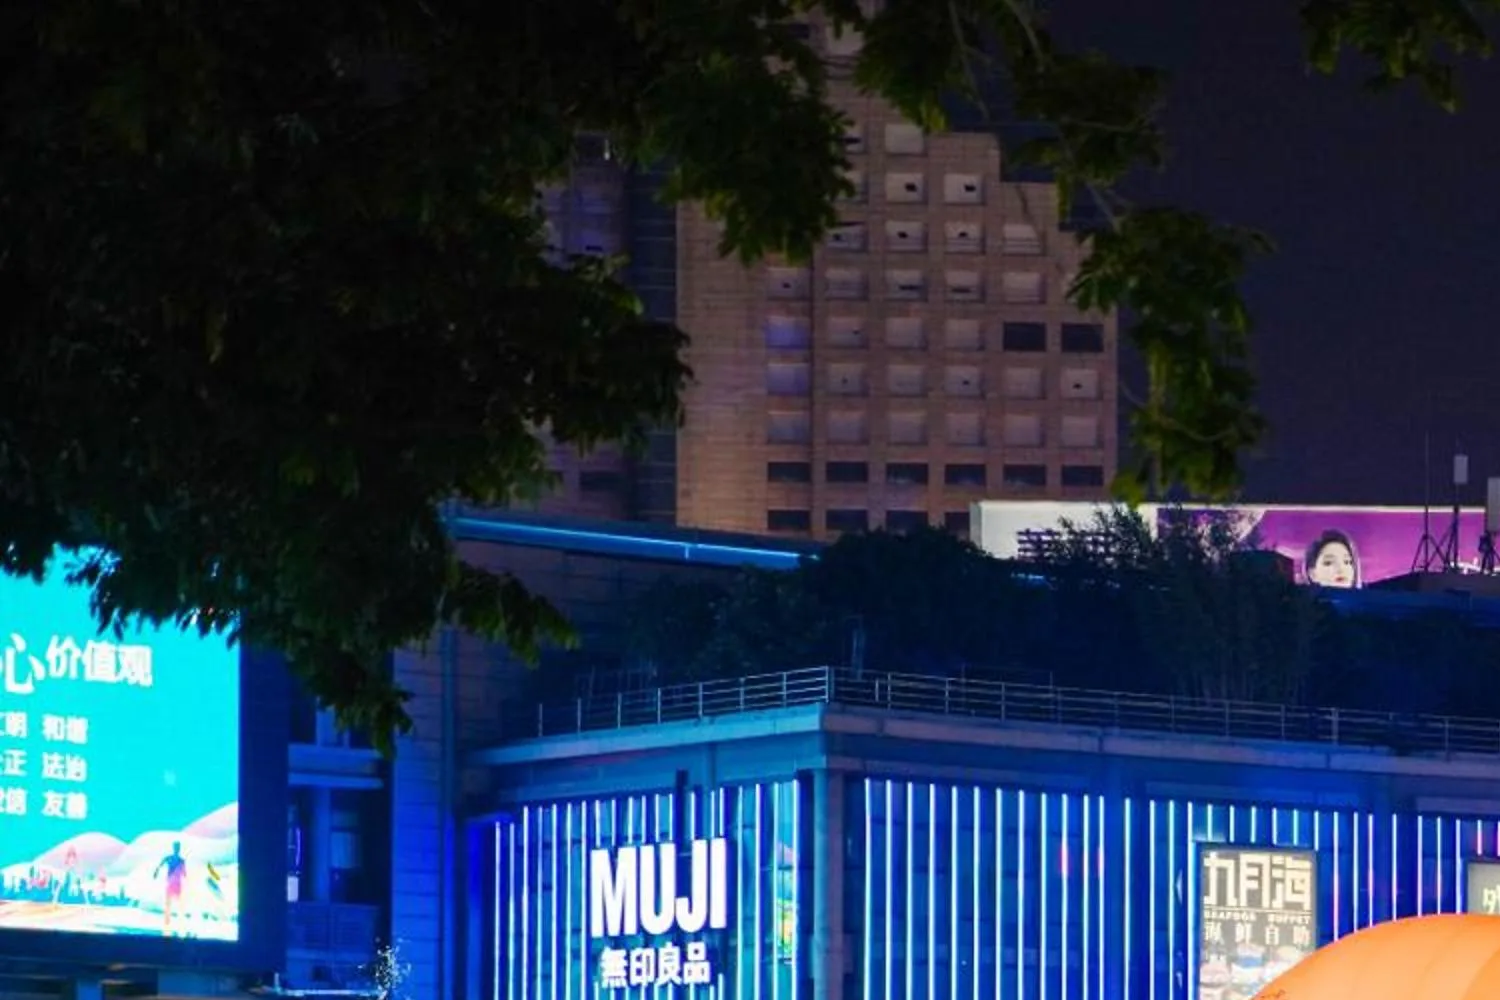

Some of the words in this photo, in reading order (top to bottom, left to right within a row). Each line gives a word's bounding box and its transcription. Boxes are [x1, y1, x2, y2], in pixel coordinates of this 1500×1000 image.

[0, 633, 153, 694] 心价值观
[0, 750, 27, 776] 正
[590, 838, 727, 938] MUJI
[602, 941, 711, 988] 無印良品
